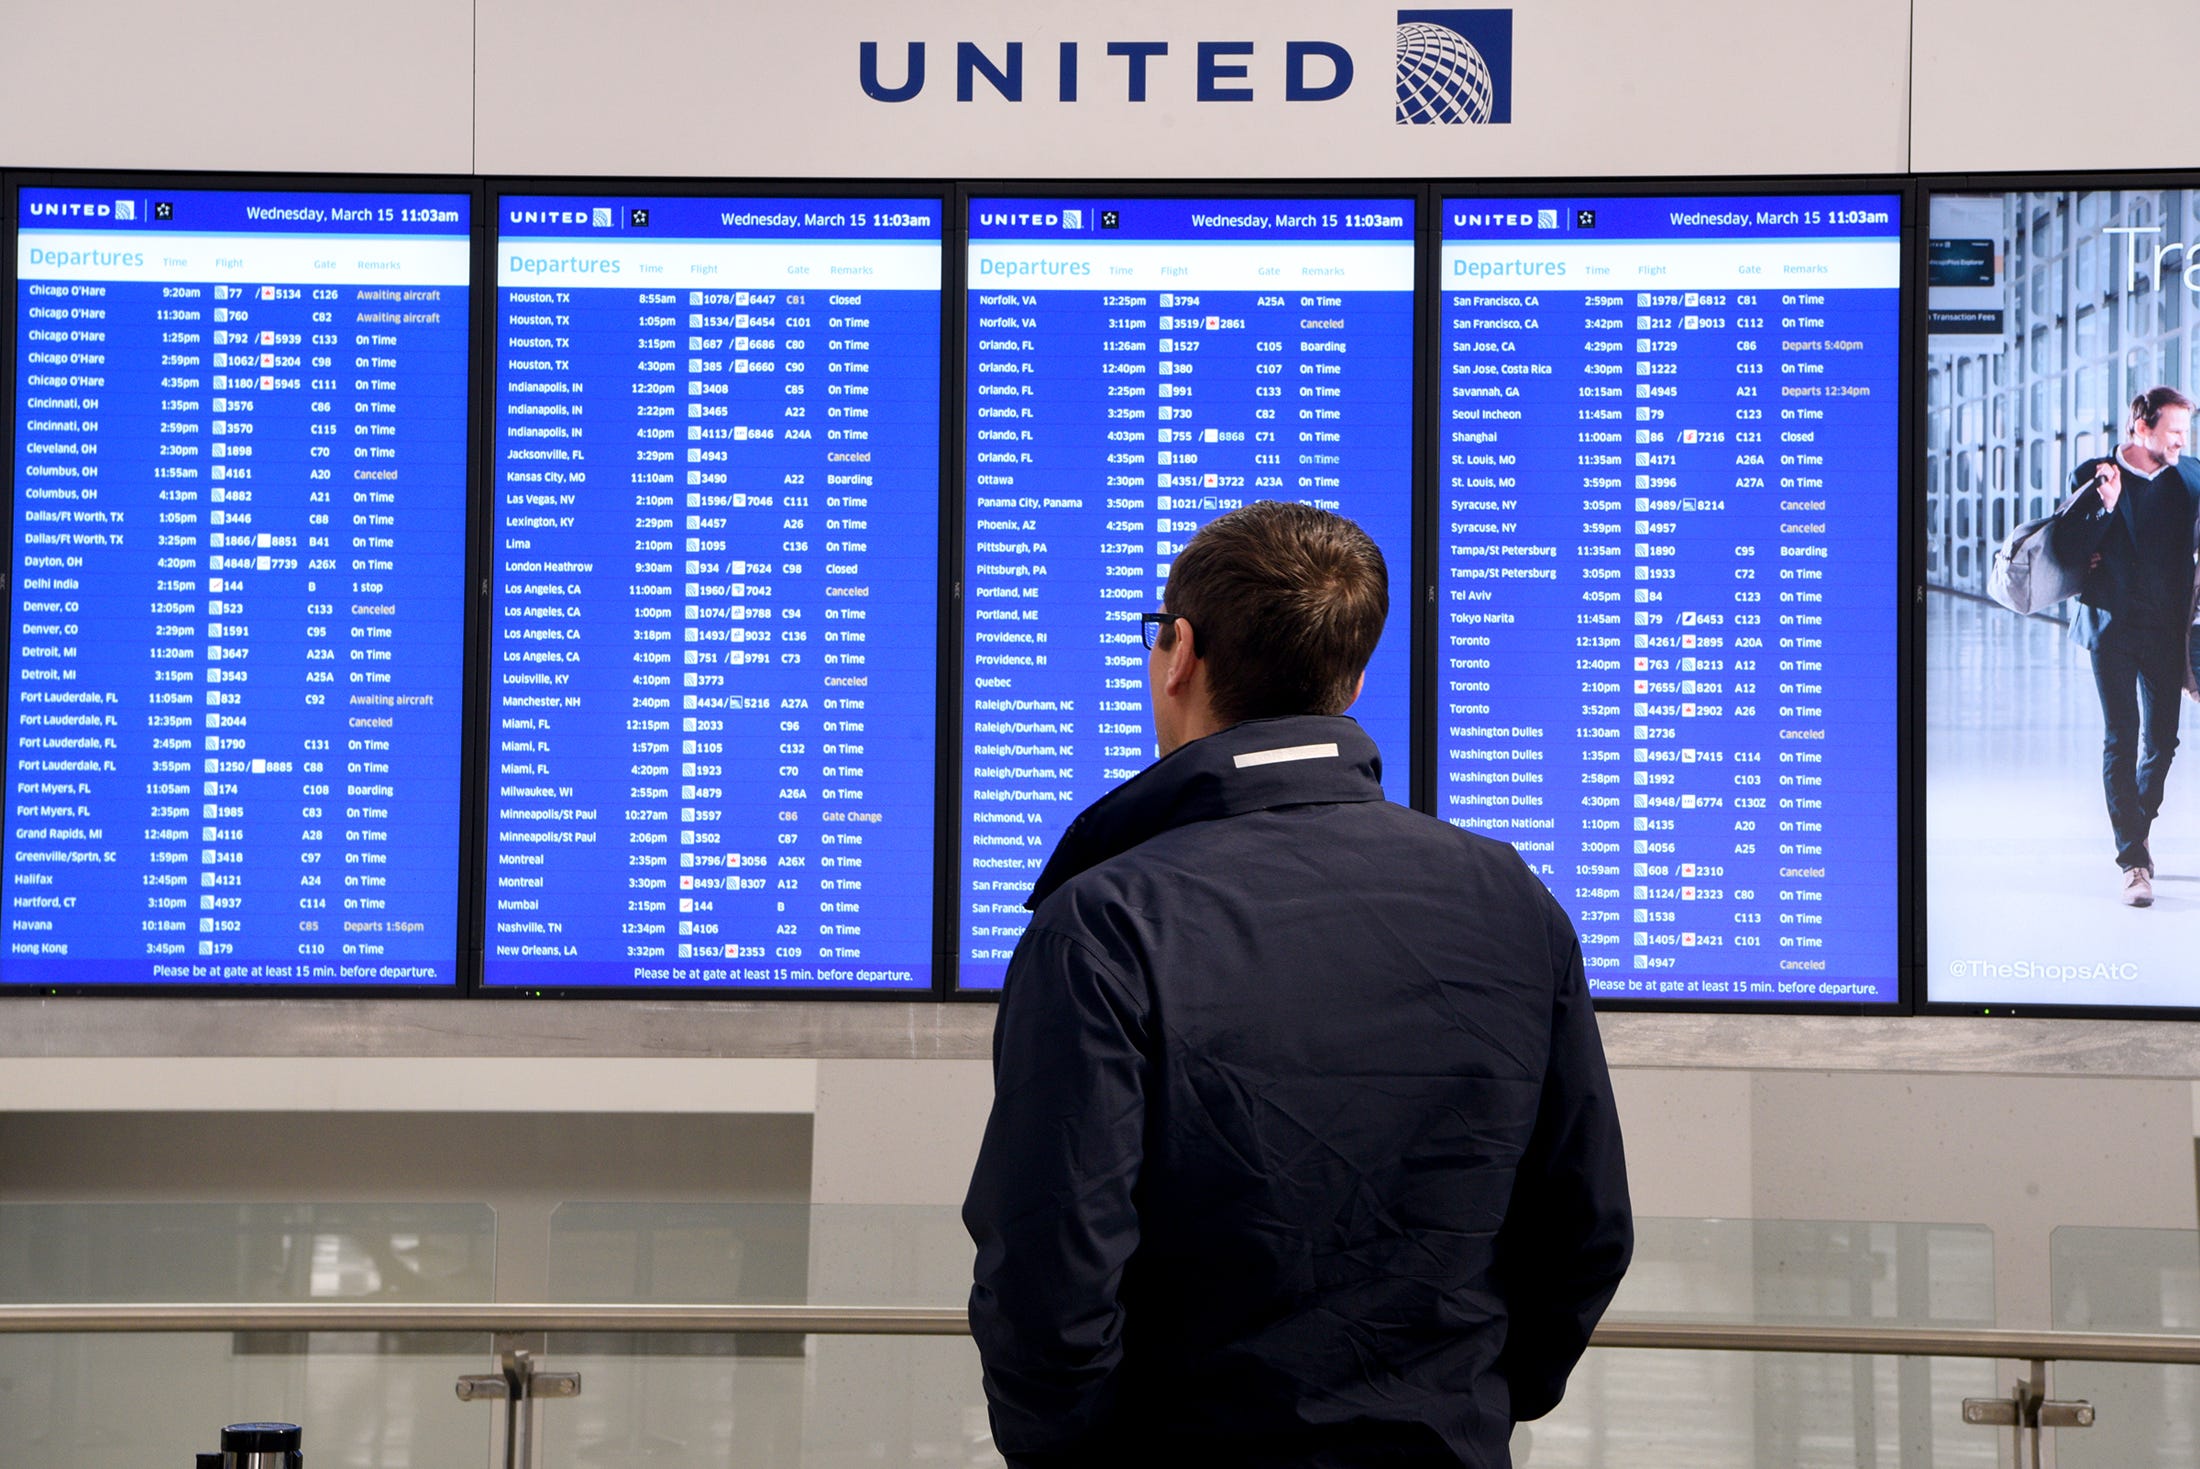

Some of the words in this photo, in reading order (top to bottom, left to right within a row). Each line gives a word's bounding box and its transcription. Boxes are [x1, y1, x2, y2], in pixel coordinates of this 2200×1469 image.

[860, 41, 1354, 103] UNITED
[30, 202, 111, 217] UNITED
[246, 206, 328, 223] Wednesday,
[331, 207, 373, 222] March
[377, 208, 394, 222] 15
[401, 208, 459, 223] 11:03am
[510, 211, 589, 224] UNITED
[720, 212, 801, 229] Wednesday,
[804, 213, 846, 227] March
[849, 213, 867, 227] 15
[873, 213, 931, 227] 11:03am
[980, 213, 1058, 226] UNITED
[1191, 213, 1272, 230] Wednesday,
[1275, 214, 1317, 228] March
[1321, 214, 1338, 228] 15
[1345, 213, 1404, 228] 11:03am
[1454, 213, 1534, 227] UNITED
[1669, 211, 1753, 228] Wednesday,
[1756, 211, 1799, 225] March
[1803, 210, 1821, 225] 15
[1828, 210, 1889, 224] 11:03am
[29, 247, 144, 269] Departures
[162, 257, 188, 267] Time
[215, 257, 244, 270] Flight
[313, 259, 337, 269] Gate
[357, 260, 401, 270] Remarks
[509, 255, 621, 276] Departures
[639, 263, 664, 274] Time
[690, 264, 718, 276] Flight
[786, 265, 810, 275] Gate
[830, 265, 874, 275] Remarks
[980, 257, 1091, 279] Departures
[1109, 265, 1134, 276] Time
[1160, 266, 1189, 277] Flight
[1257, 266, 1281, 276] Gate
[1301, 266, 1345, 276] Remarks
[1453, 259, 1567, 280] Departures
[1585, 265, 1611, 275] Time
[1637, 265, 1667, 277] Flight
[1738, 264, 1762, 275] Gate
[1783, 263, 1829, 274] Remarks
[979, 294, 1020, 306] Norfolk,
[1021, 295, 1038, 306] VA
[1103, 295, 1147, 308] 12:25pm
[1173, 295, 1201, 307] 3794
[1256, 296, 1286, 307] A25A
[1300, 296, 1317, 307] On
[1317, 295, 1342, 307] Time
[28, 306, 69, 321] Chicago
[70, 307, 106, 320] O'Hare
[156, 309, 201, 321] 11:30am
[228, 310, 249, 322] 760
[311, 311, 333, 323] C82
[356, 311, 402, 325] Awaiting
[402, 312, 441, 324] aircraft
[1932, 312, 1977, 321] Transaction
[1978, 312, 1996, 321] Fees
[1452, 341, 1472, 352] San
[1472, 341, 1502, 353] Jose,
[1501, 341, 1516, 352] CA
[1584, 341, 1624, 353] 4:29pm
[1650, 340, 1678, 352] 1729
[1736, 340, 1757, 352] C86
[1781, 340, 1823, 352] Departs
[1823, 339, 1864, 352] 5:40pm
[508, 381, 570, 394] Indianapolis,
[571, 382, 584, 393] IN
[631, 382, 676, 395] 12:20pm
[702, 383, 729, 395] 3408
[784, 384, 805, 395] C85
[827, 384, 844, 396] On
[844, 384, 870, 396] Time
[25, 464, 79, 478] Columbus,
[79, 465, 99, 478] OH
[154, 467, 199, 478] 11:55am
[225, 467, 252, 479] 4161
[309, 468, 332, 480] A20
[353, 469, 399, 481] Canceled
[976, 519, 1021, 531] Phoenix,
[1021, 519, 1037, 531] AZ
[1105, 520, 1145, 533] 4:25pm
[1171, 520, 1198, 532] 1929
[1450, 544, 1500, 557] Tampa/St
[1500, 544, 1557, 558] Petersburg
[1577, 545, 1622, 556] 11:35am
[1649, 545, 1676, 557] 1890
[1734, 545, 1756, 557] C95
[1780, 545, 1828, 559] Boarding
[974, 676, 1012, 689] Quebec
[1104, 677, 1143, 690] 1:35pm
[1449, 771, 1510, 785] Washington
[1511, 771, 1544, 783] Dulles
[1581, 772, 1621, 785] 2:58pm
[1648, 773, 1675, 785] 1992
[1733, 774, 1762, 785] C103
[1778, 774, 1796, 786] On
[1796, 774, 1823, 786] Time
[17, 782, 37, 794] Fort
[37, 782, 77, 796] Myers,
[78, 782, 92, 794] FL
[146, 783, 191, 795] 11:05am
[218, 783, 238, 795] 174
[302, 784, 330, 796] C108
[347, 784, 394, 798] Boarding
[499, 808, 574, 821] Minneapolis/St
[575, 808, 597, 820] Paul
[624, 809, 669, 821] 10:27am
[694, 810, 722, 821] 3597
[778, 810, 799, 822] C86
[821, 811, 848, 822] Gate
[849, 810, 883, 824] Change
[973, 811, 1026, 824] Richmond,
[1026, 812, 1043, 824] VA
[497, 921, 546, 934] Nashville,
[547, 922, 563, 933] TN
[621, 922, 666, 935] 12:34pm
[692, 923, 719, 935] 4106
[776, 924, 798, 935] A22
[819, 924, 836, 935] On
[836, 923, 862, 936] Time
[11, 942, 38, 956] Hong
[39, 942, 68, 956] Kong
[146, 942, 186, 955] 3:45pm
[213, 943, 234, 955] 179
[297, 943, 325, 955] C110
[342, 943, 359, 955] On
[359, 943, 385, 955] Time
[153, 964, 190, 977] Please
[192, 964, 208, 977] be
[209, 965, 222, 977] at
[223, 965, 249, 979] gate
[250, 965, 263, 977] at
[265, 964, 293, 977] least
[295, 965, 311, 978] 15
[312, 964, 337, 977] min.
[339, 964, 378, 978] before
[379, 965, 438, 979] departure.
[1588, 978, 1626, 991] Please
[1628, 978, 1643, 991] be
[1644, 979, 1657, 991] at
[1659, 980, 1685, 993] gate
[1686, 980, 1700, 992] at
[1701, 979, 1730, 993] least
[1732, 980, 1748, 993] 15
[1749, 980, 1775, 993] min.
[1777, 981, 1817, 994] before
[1818, 981, 1879, 996] departure.
